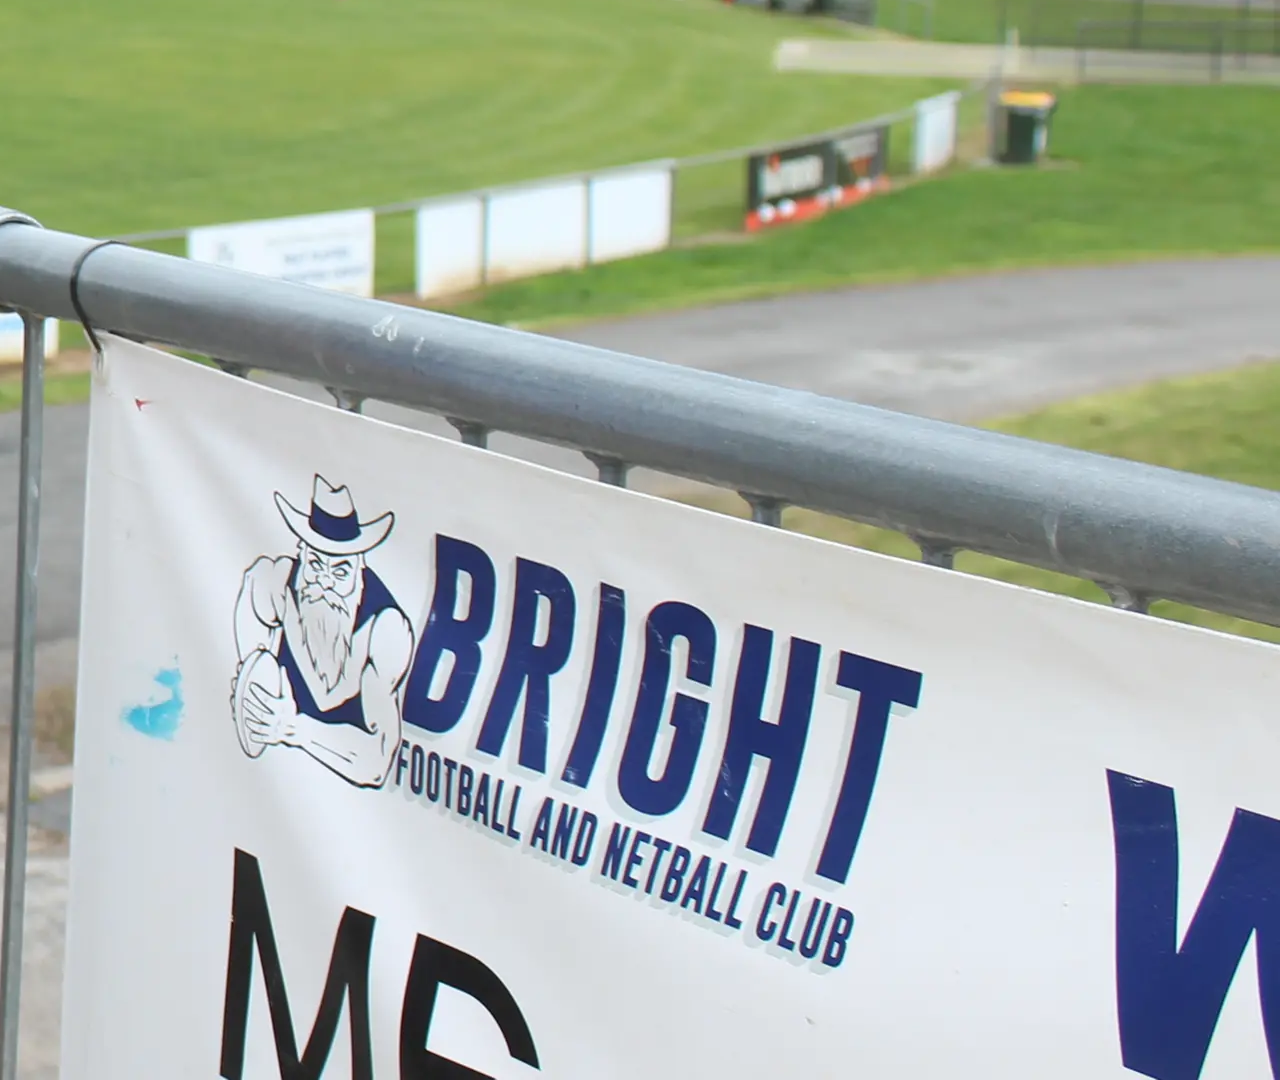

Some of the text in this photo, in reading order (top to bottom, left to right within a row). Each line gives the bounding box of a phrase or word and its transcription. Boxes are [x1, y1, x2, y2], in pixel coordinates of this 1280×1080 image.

[395, 740, 855, 969] FOOTBALL AND NETBALL CLUB
[401, 532, 923, 886] BRIGHT
